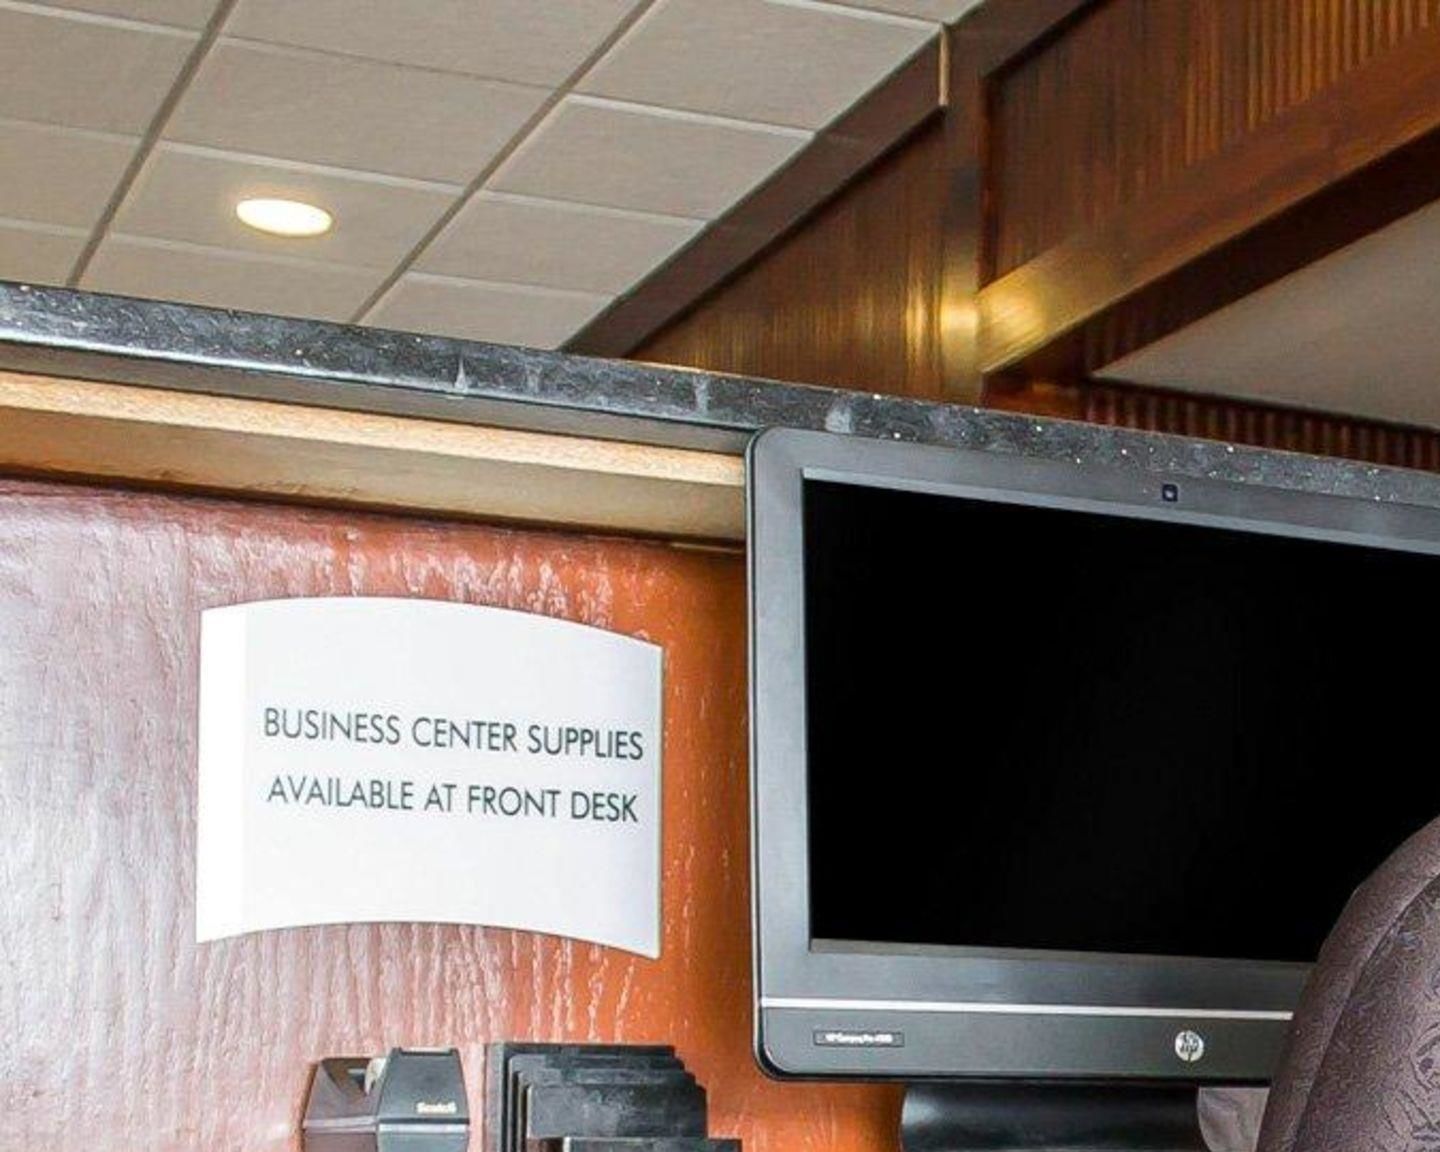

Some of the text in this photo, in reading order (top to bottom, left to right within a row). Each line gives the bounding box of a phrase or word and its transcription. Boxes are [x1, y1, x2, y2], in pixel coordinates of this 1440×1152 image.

[264, 707, 645, 761] BUSINESS CENTER SUPPLIES
[267, 775, 640, 824] AVAILABLE AT FRONT DESK
